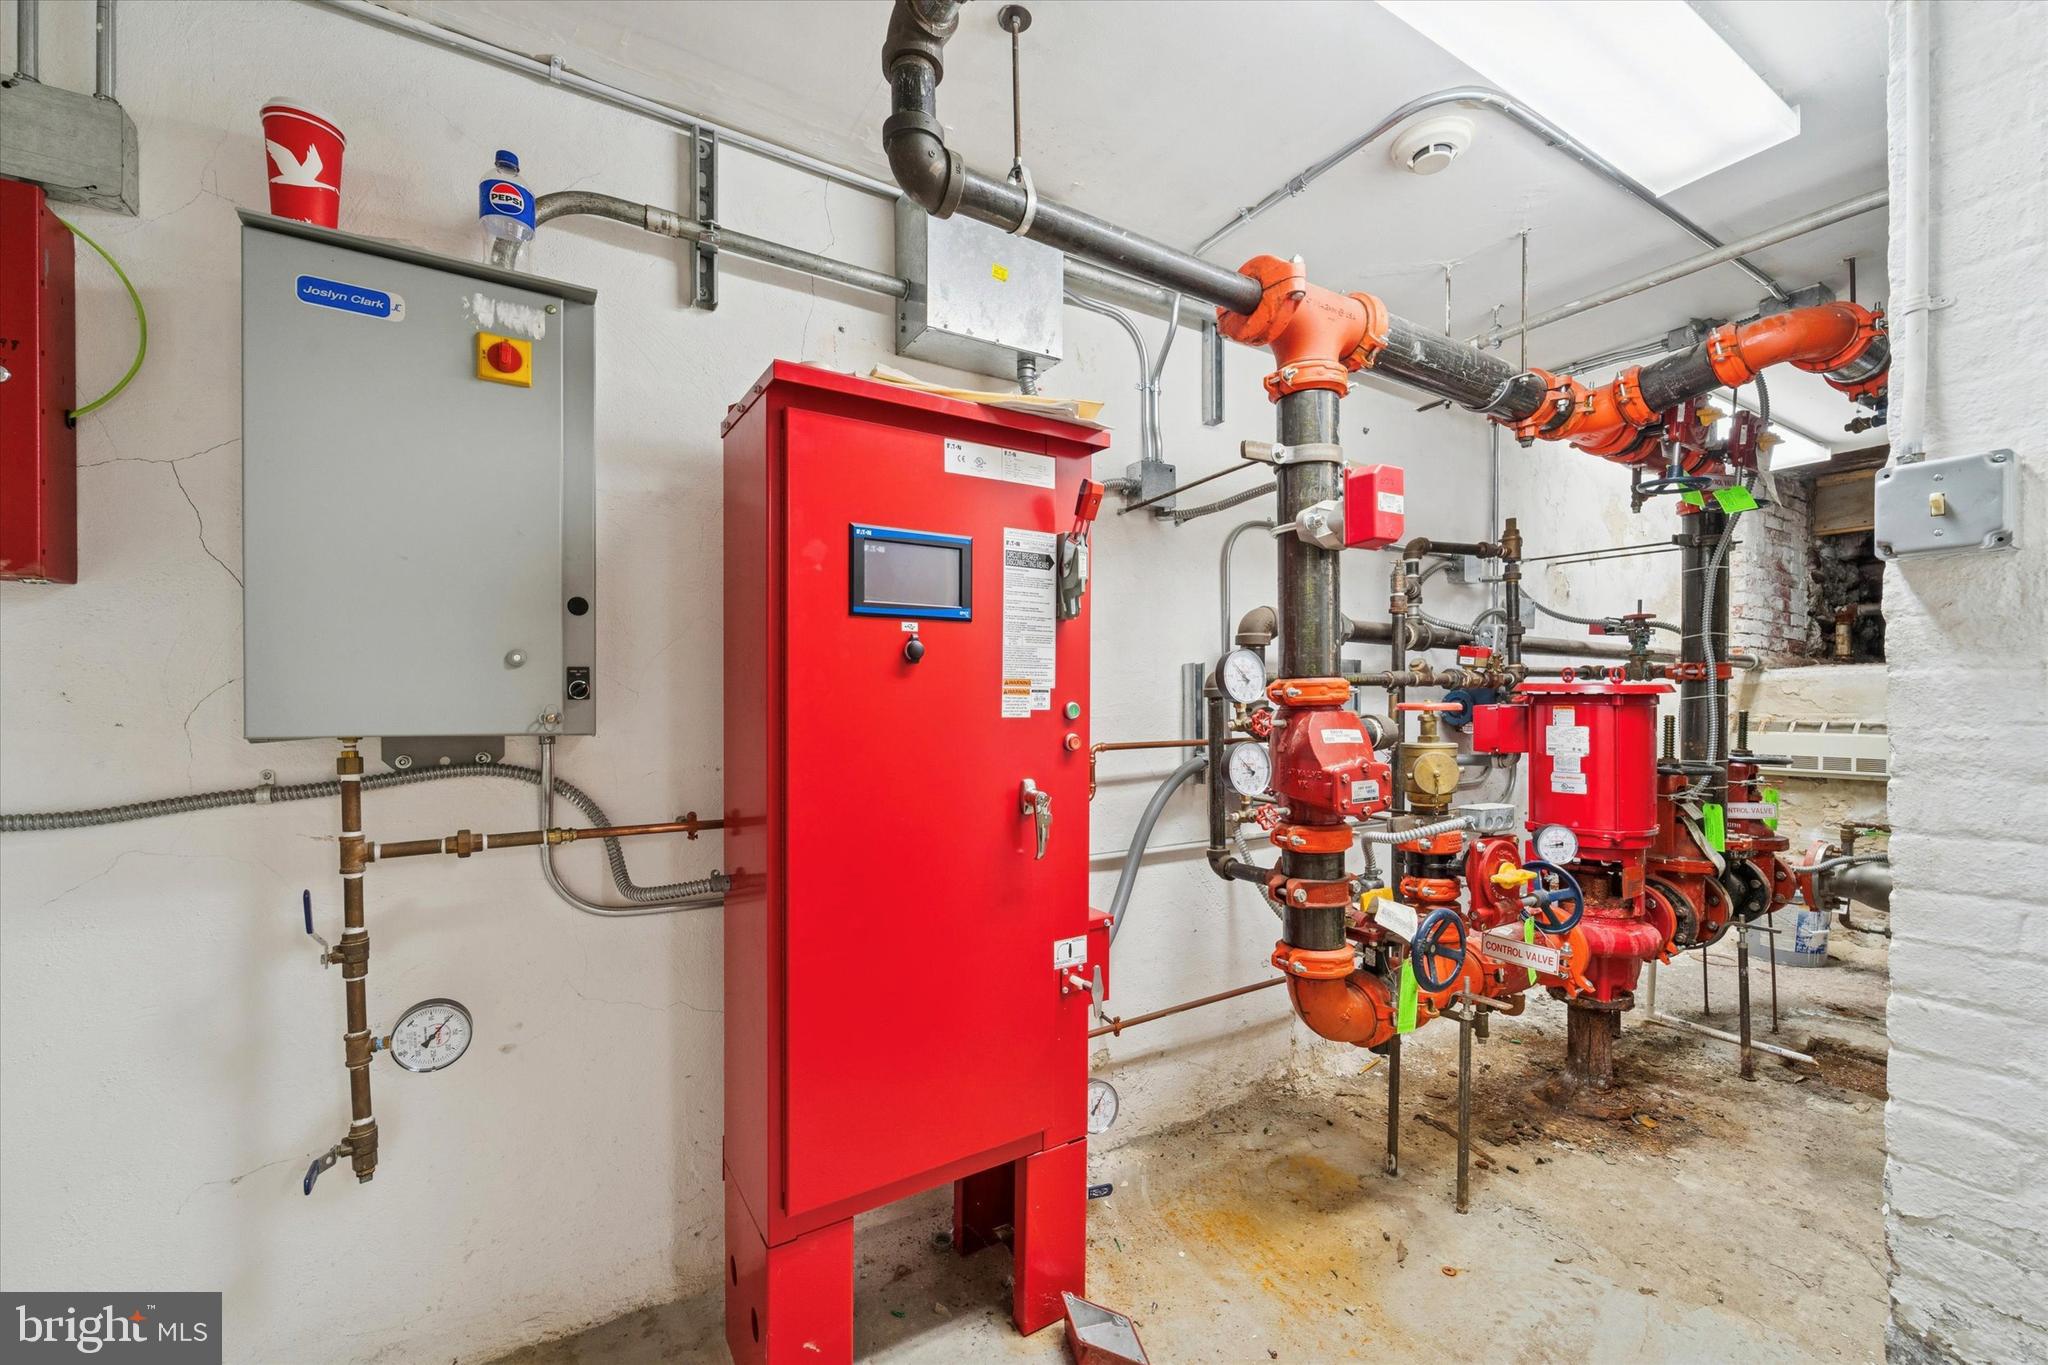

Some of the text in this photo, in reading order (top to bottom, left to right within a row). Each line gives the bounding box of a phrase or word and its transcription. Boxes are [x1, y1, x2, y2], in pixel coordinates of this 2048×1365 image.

[491, 193, 523, 207] PEPSI
[303, 285, 347, 301] Joslyn
[351, 295, 384, 310] Clark
[1485, 941, 1554, 966] CONTROL VALVE
